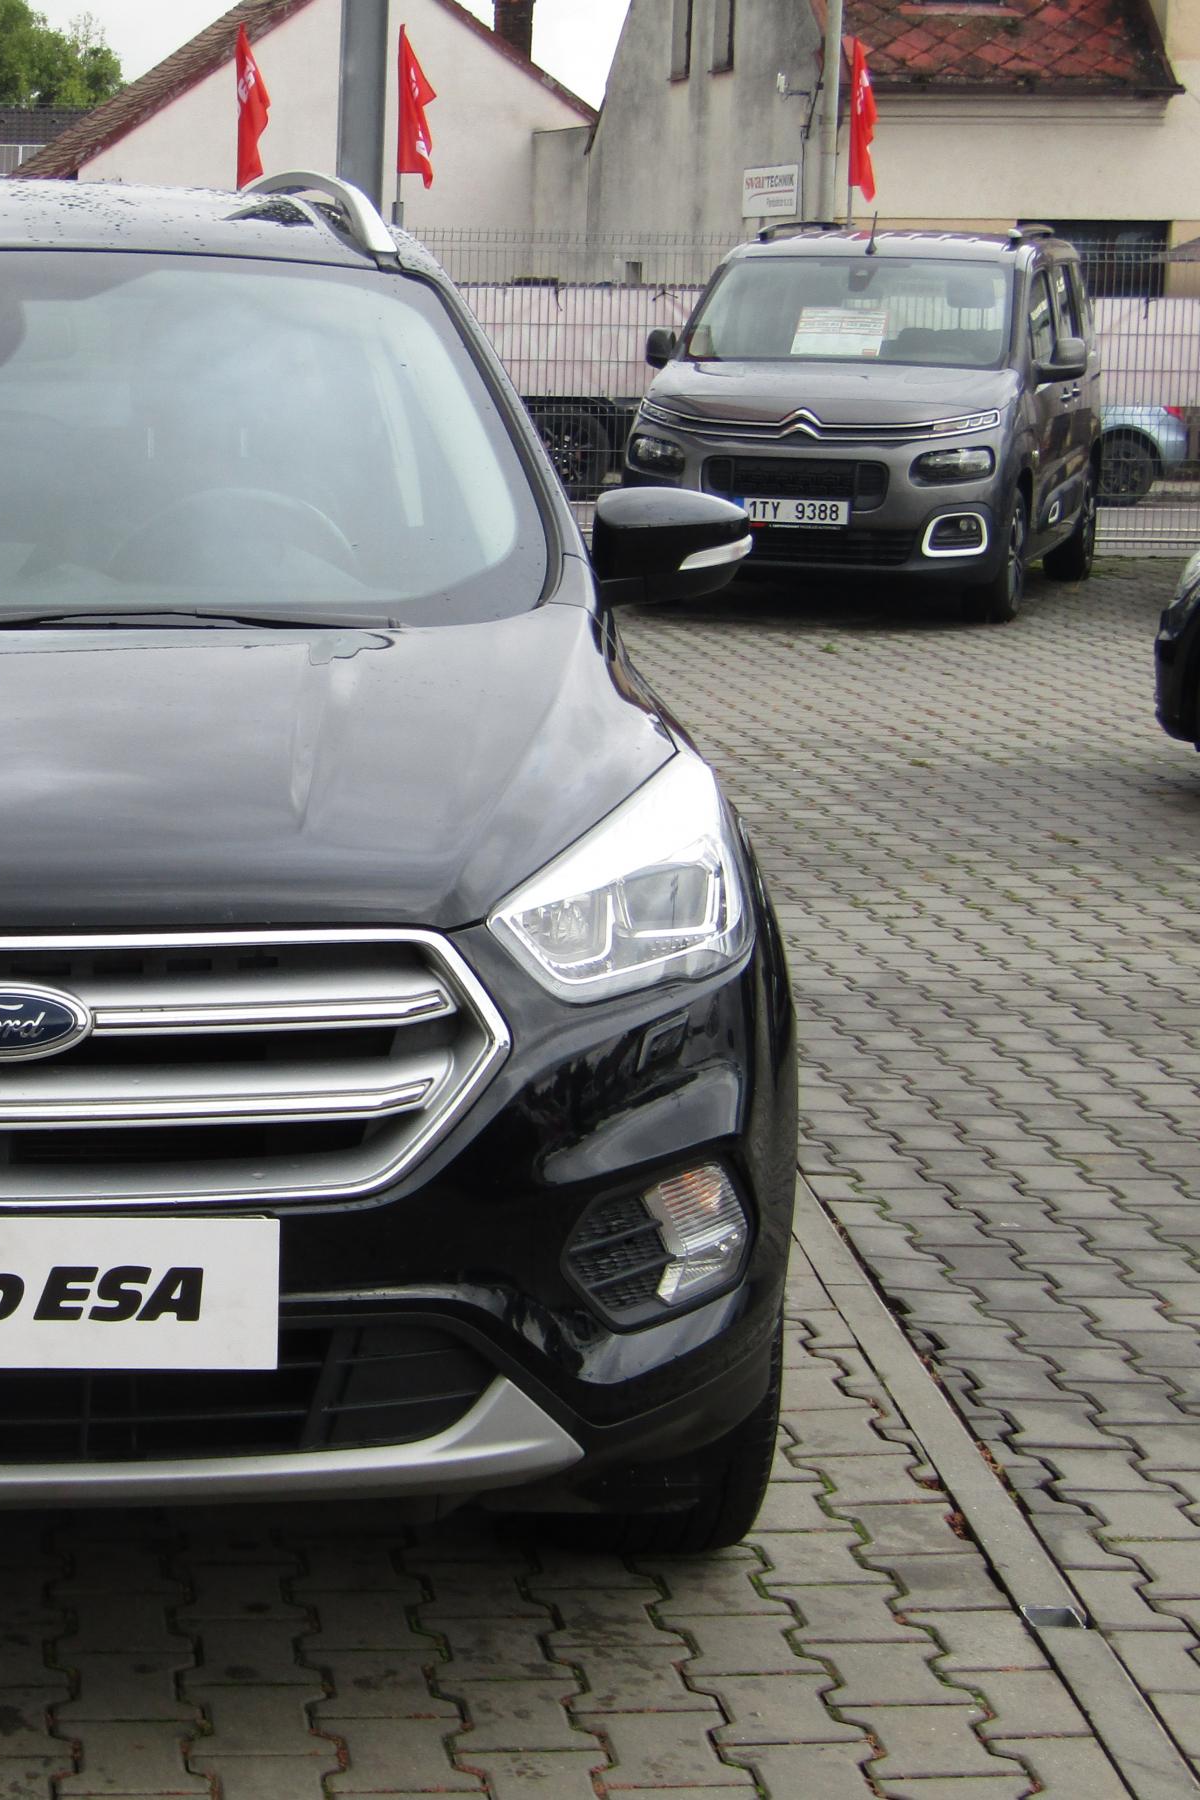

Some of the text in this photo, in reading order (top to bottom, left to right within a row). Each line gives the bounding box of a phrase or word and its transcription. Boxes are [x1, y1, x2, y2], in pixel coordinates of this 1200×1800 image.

[749, 501, 839, 521] 1TY 9388
[33, 1265, 204, 1322] ESA
